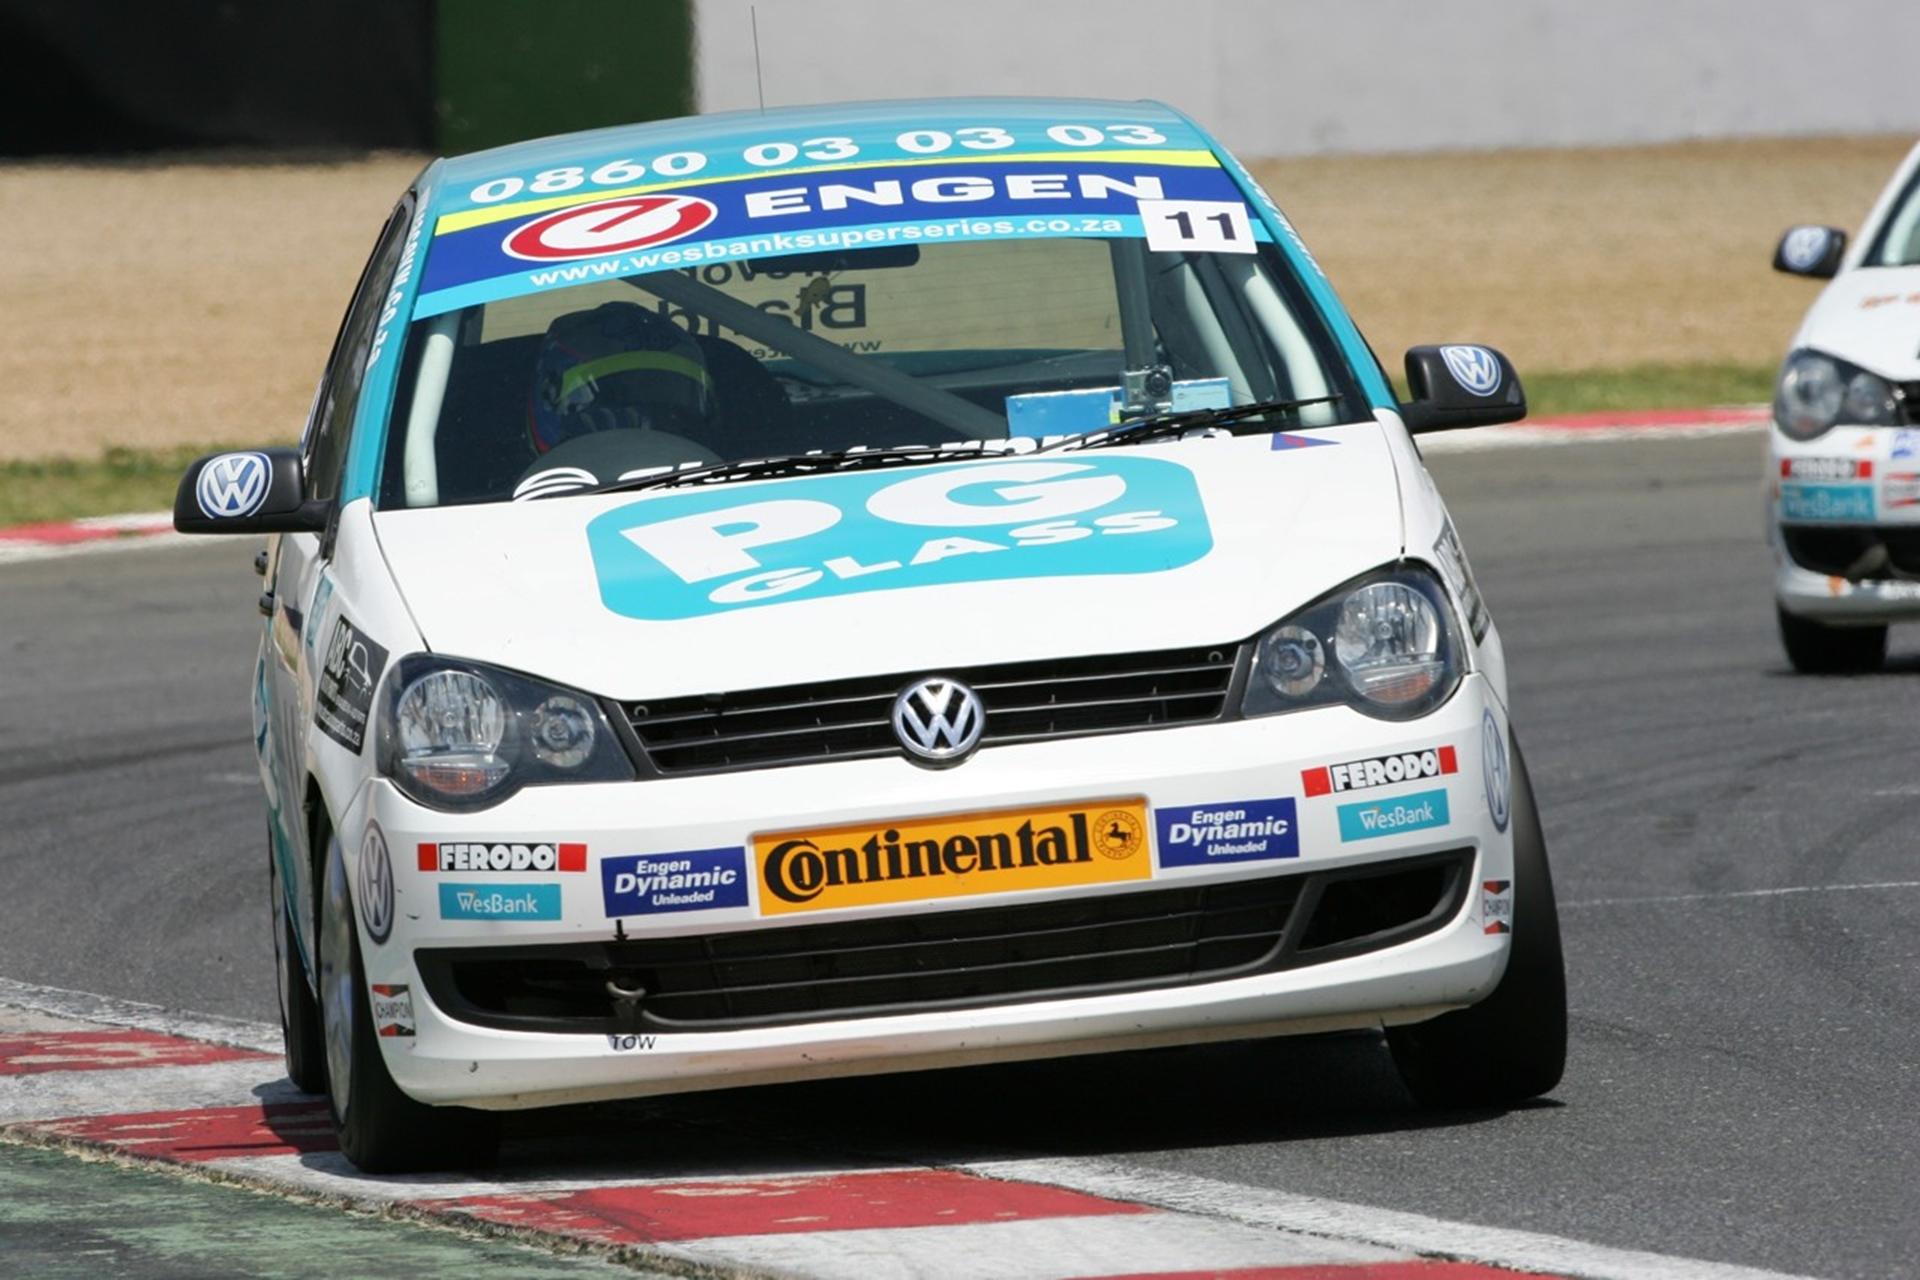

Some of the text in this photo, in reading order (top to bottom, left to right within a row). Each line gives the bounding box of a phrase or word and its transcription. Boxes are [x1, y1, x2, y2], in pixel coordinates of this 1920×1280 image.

[469, 124, 1167, 204] 0860 03 03 03
[744, 174, 1165, 218] ENGEN
[1165, 211, 1237, 241] 11
[530, 218, 1122, 287] www.wesbanksuperseries.co.za
[618, 462, 1127, 584] PG
[708, 511, 1178, 604] GLASS
[892, 677, 985, 761] VW
[1333, 752, 1438, 792] FERODO
[1192, 808, 1245, 826] Engen
[1359, 802, 1434, 831] WesBank
[1169, 817, 1288, 848] Dynamic
[440, 844, 556, 871] FERODO
[764, 813, 1093, 903] Continental
[1207, 840, 1267, 857] Unleaded
[636, 858, 691, 877] Engen
[614, 867, 737, 900] Dynamic
[652, 890, 714, 907] Unleaded
[457, 891, 538, 914] WesBank
[611, 1035, 656, 1051] TOW
